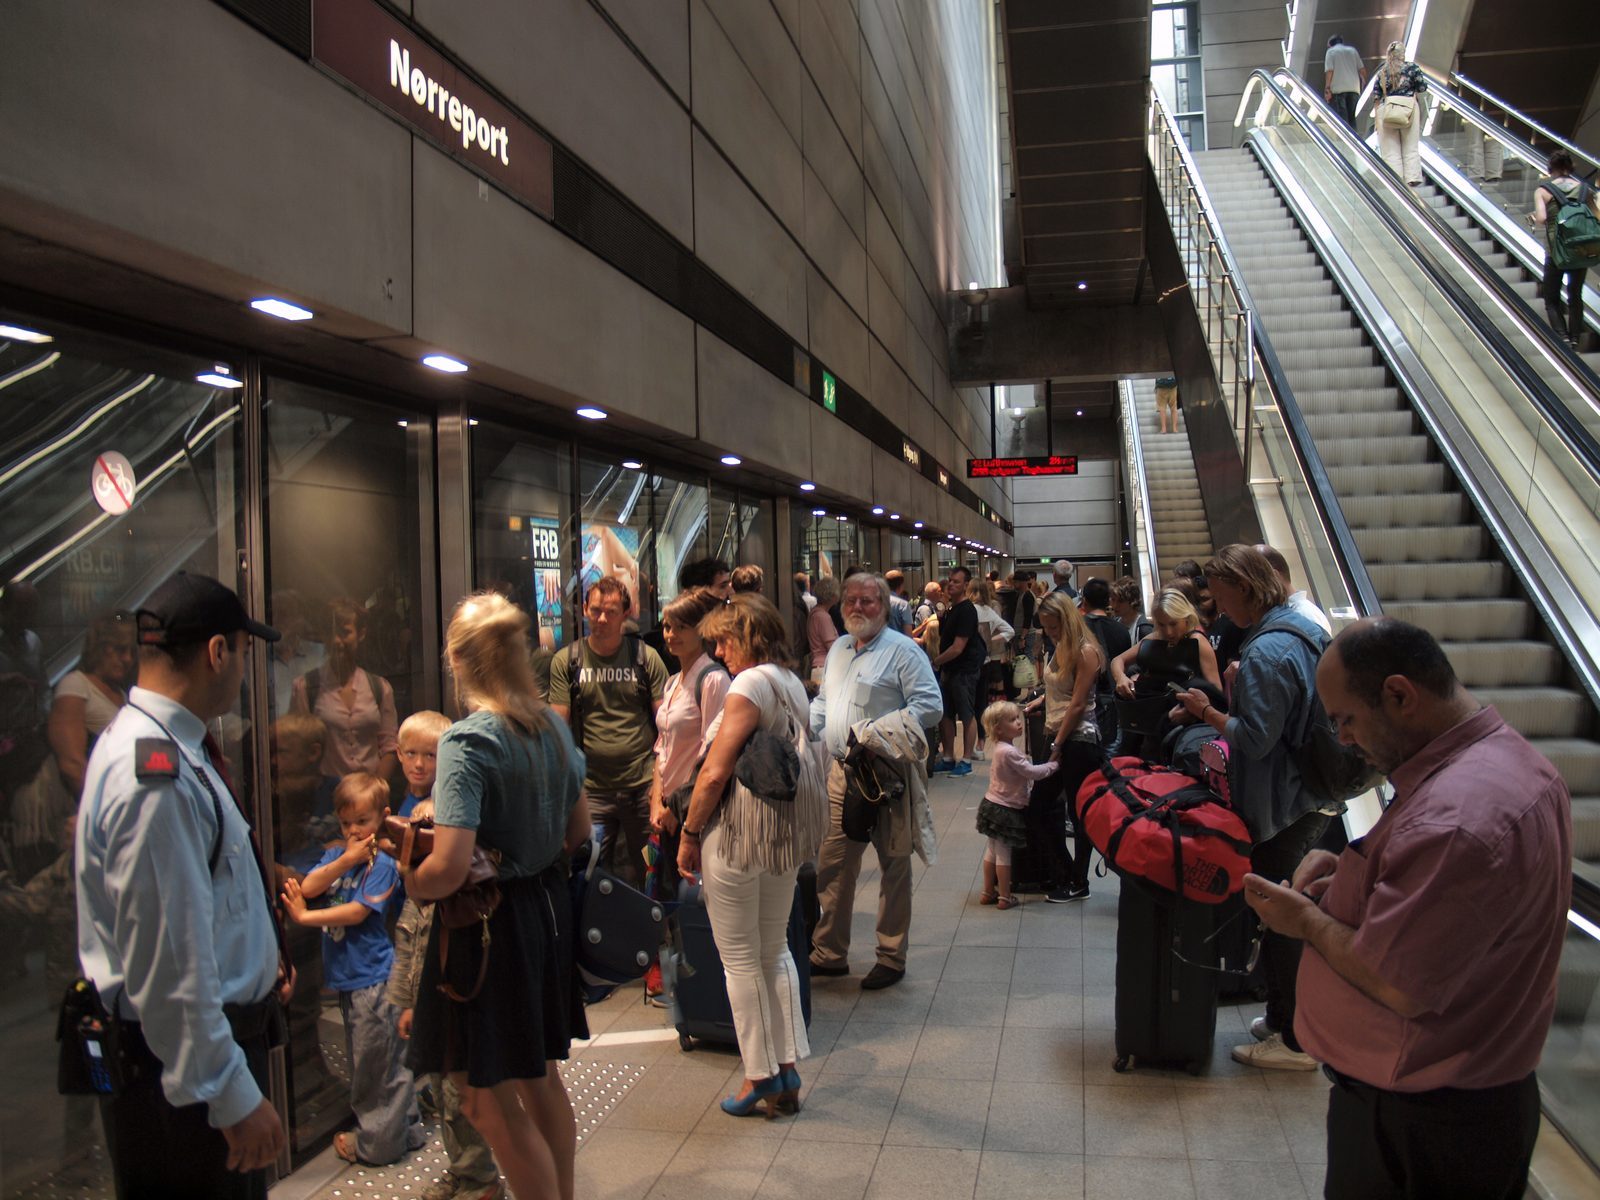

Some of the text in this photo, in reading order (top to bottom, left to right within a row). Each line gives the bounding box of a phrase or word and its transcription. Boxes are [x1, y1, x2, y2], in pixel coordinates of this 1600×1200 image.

[390, 38, 509, 166] Nørreport
[579, 667, 593, 682] AT
[1183, 864, 1213, 881] ORTH
[1195, 856, 1218, 873] THE
[1183, 878, 1208, 892] ACE
